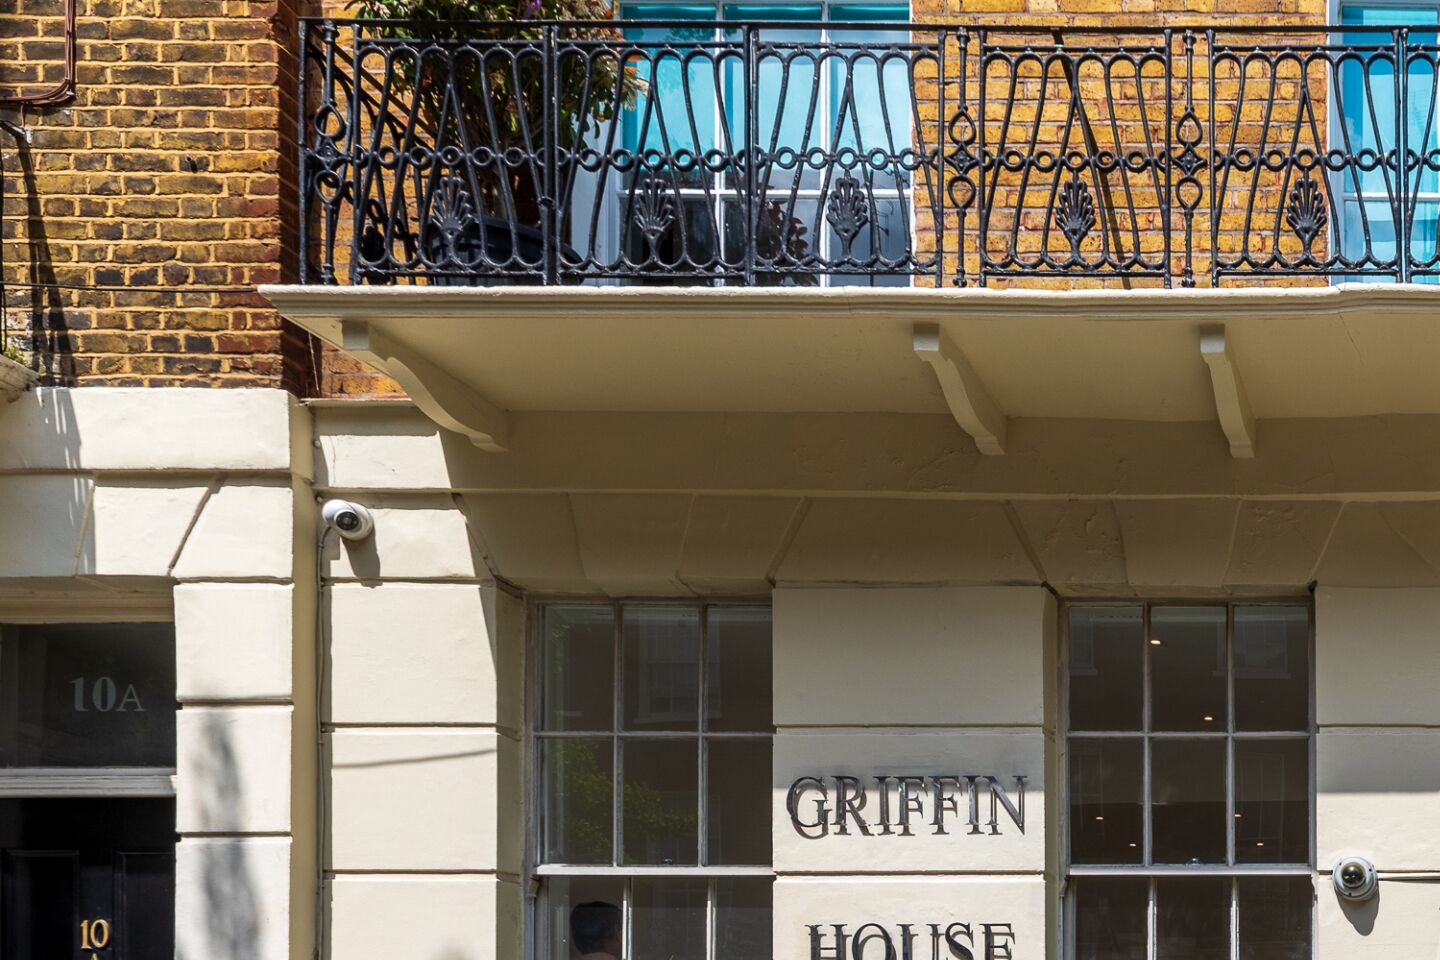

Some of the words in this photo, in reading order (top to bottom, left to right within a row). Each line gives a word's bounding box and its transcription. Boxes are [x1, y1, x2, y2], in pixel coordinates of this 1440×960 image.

[69, 676, 145, 712] 10A
[786, 775, 1028, 831] GRIFFIN
[80, 919, 109, 949] 10
